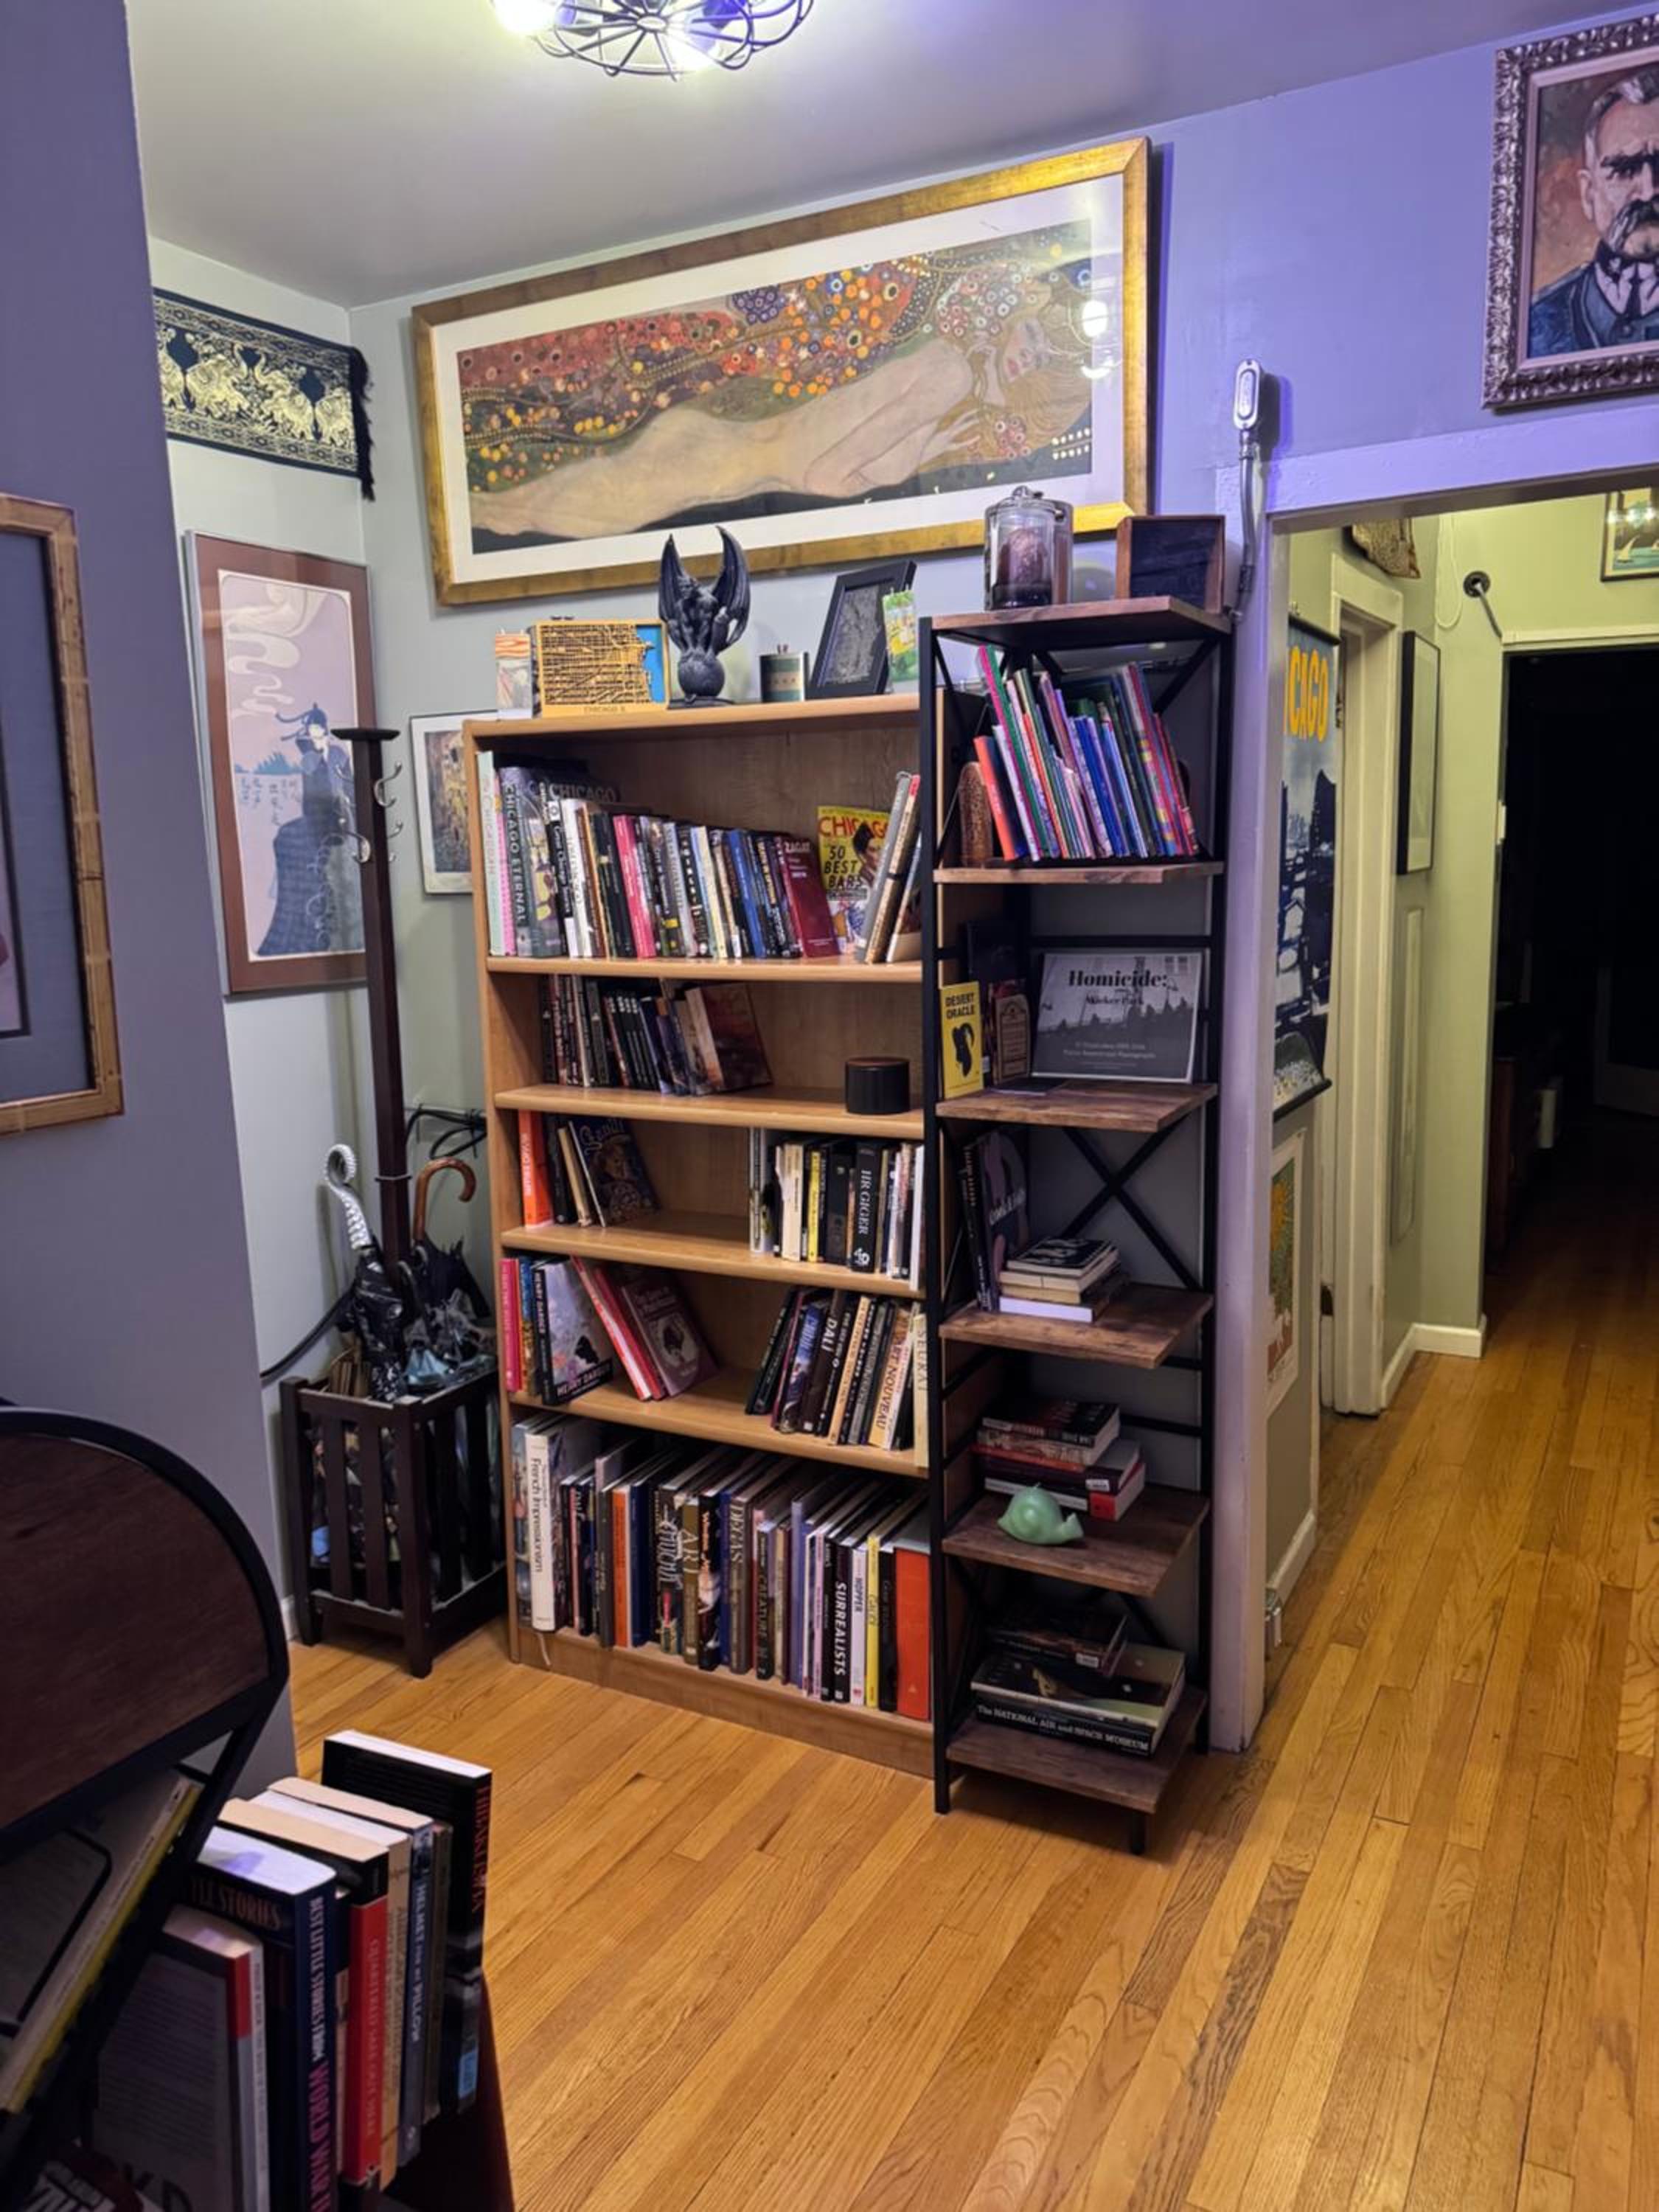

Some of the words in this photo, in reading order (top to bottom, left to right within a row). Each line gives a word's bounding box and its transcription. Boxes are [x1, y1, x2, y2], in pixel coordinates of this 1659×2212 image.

[1284, 645, 1329, 742] CAGO
[818, 815, 889, 841] CHICG
[504, 784, 520, 853] CHICAGO
[512, 857, 526, 923] ETERNAL
[824, 860, 860, 874] BEST
[829, 845, 846, 860] 50
[827, 874, 863, 888] BARS
[945, 992, 975, 1008] DESERT
[1068, 970, 1168, 987] Homicide:
[946, 1004, 976, 1020] ORACLE
[858, 1190, 872, 1235] GIGER
[875, 1364, 900, 1430] NOUVEAU
[531, 1458, 543, 1497] French
[532, 1499, 546, 1573] Impressionism
[729, 1503, 745, 1564] DEGAS
[854, 1577, 864, 1614] HOPPER
[833, 1580, 848, 1677] SURREALISTS
[992, 1708, 1038, 1727] NATIONAL
[1038, 1717, 1057, 1732] AIR
[1074, 1726, 1103, 1742] SPACE
[1105, 1733, 1150, 1751] MUSEUM
[310, 1896, 324, 1926] BEST
[414, 1884, 428, 1943] HELMET
[310, 1927, 325, 1970] LITTLE
[310, 1972, 327, 2023] STORIES
[366, 1938, 381, 2025] QUARTERED
[410, 1983, 425, 2042] PILLOW
[311, 2025, 329, 2061] FROM
[309, 2062, 331, 2143] WORLD
[309, 2143, 332, 2192] WAR
